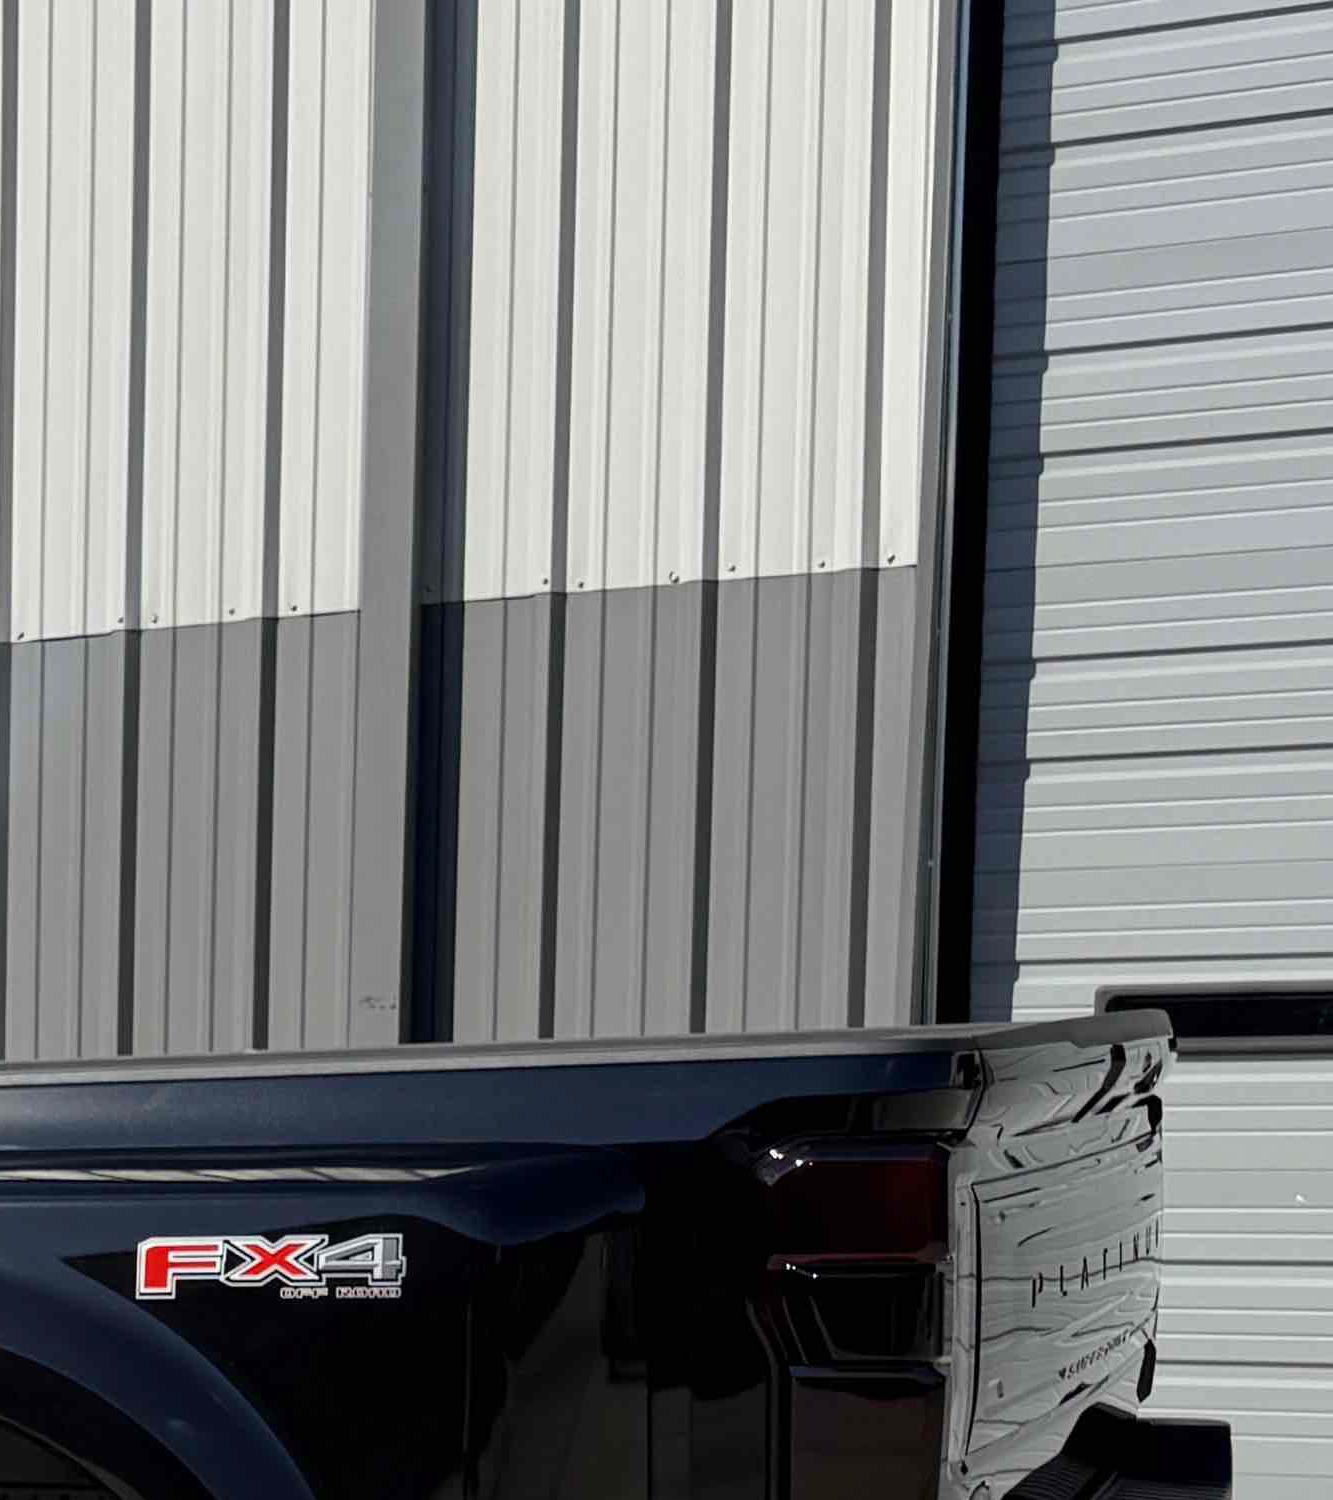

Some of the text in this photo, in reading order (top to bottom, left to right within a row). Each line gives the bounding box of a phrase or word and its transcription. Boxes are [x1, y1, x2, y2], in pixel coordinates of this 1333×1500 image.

[135, 1233, 407, 1300] FX4
[280, 1286, 402, 1300] OFF ROAD
